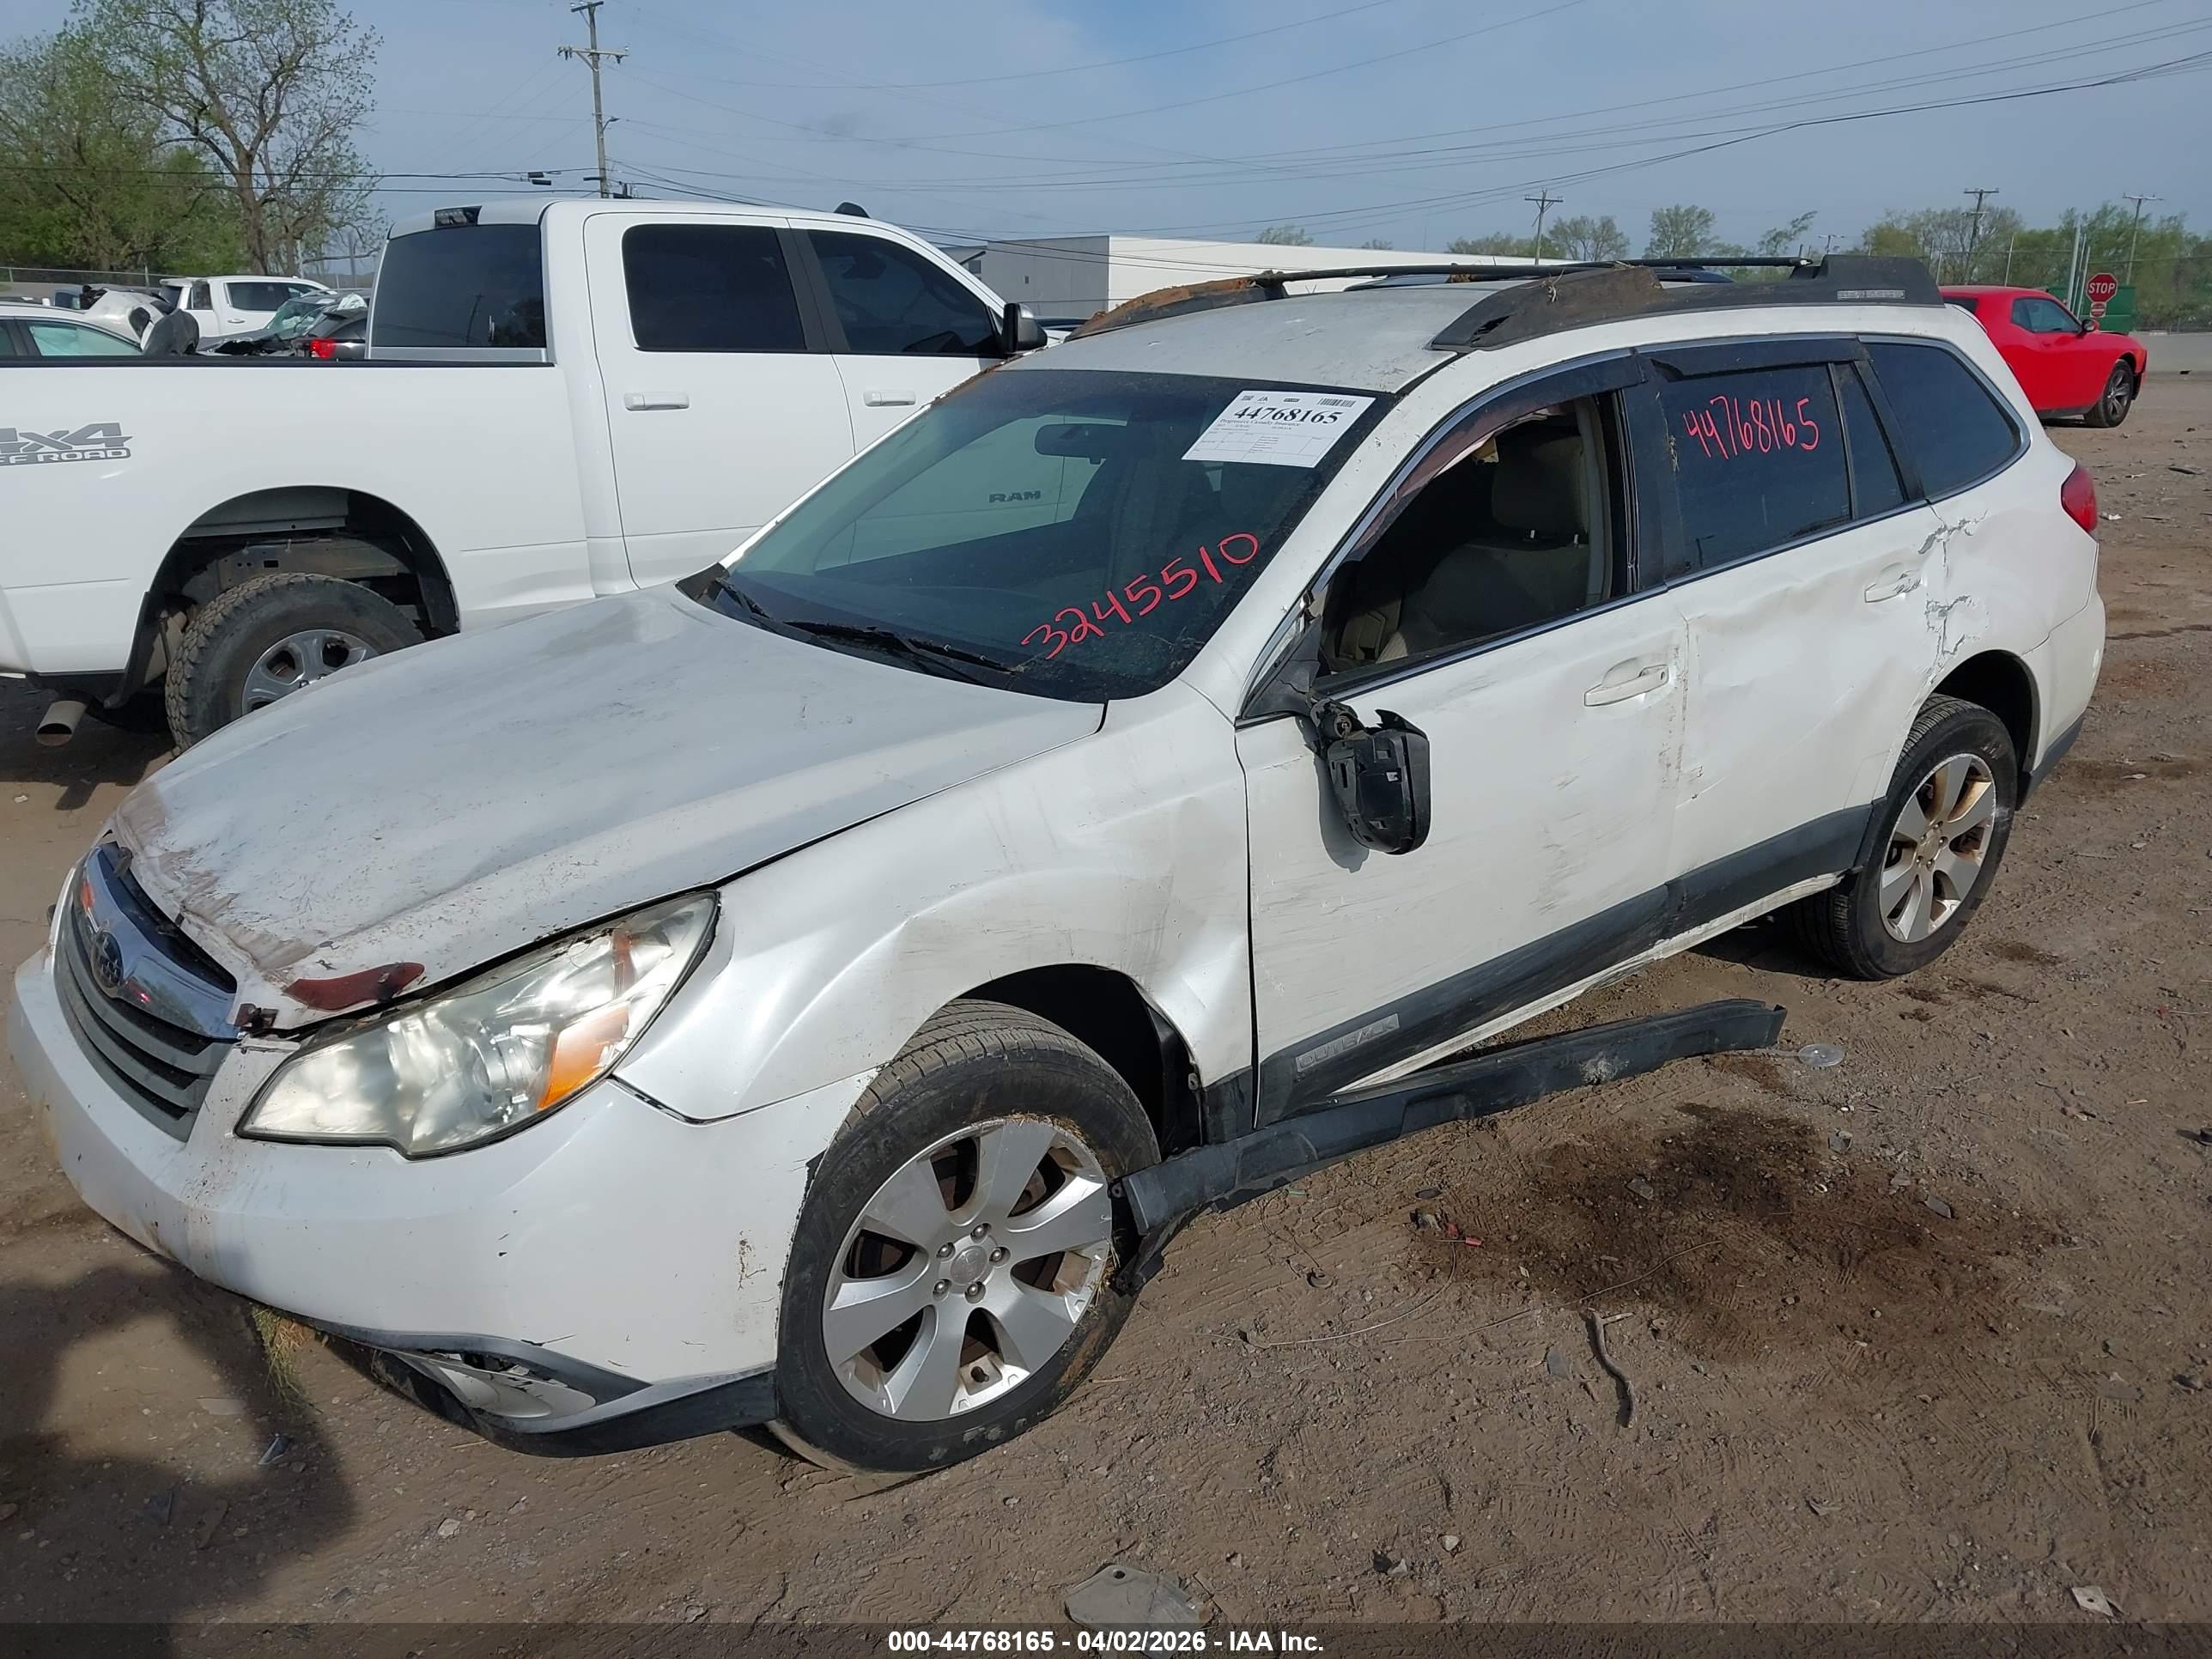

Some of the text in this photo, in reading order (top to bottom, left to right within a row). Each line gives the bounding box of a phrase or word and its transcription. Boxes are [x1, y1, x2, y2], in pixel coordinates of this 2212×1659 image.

[2088, 282, 2116, 294] STOP
[1233, 406, 1345, 425] 44768165
[1682, 394, 1820, 460] 44768165
[37, 448, 128, 462] ROAD
[988, 490, 1042, 503] RAM
[1020, 532, 1260, 660] 3245510
